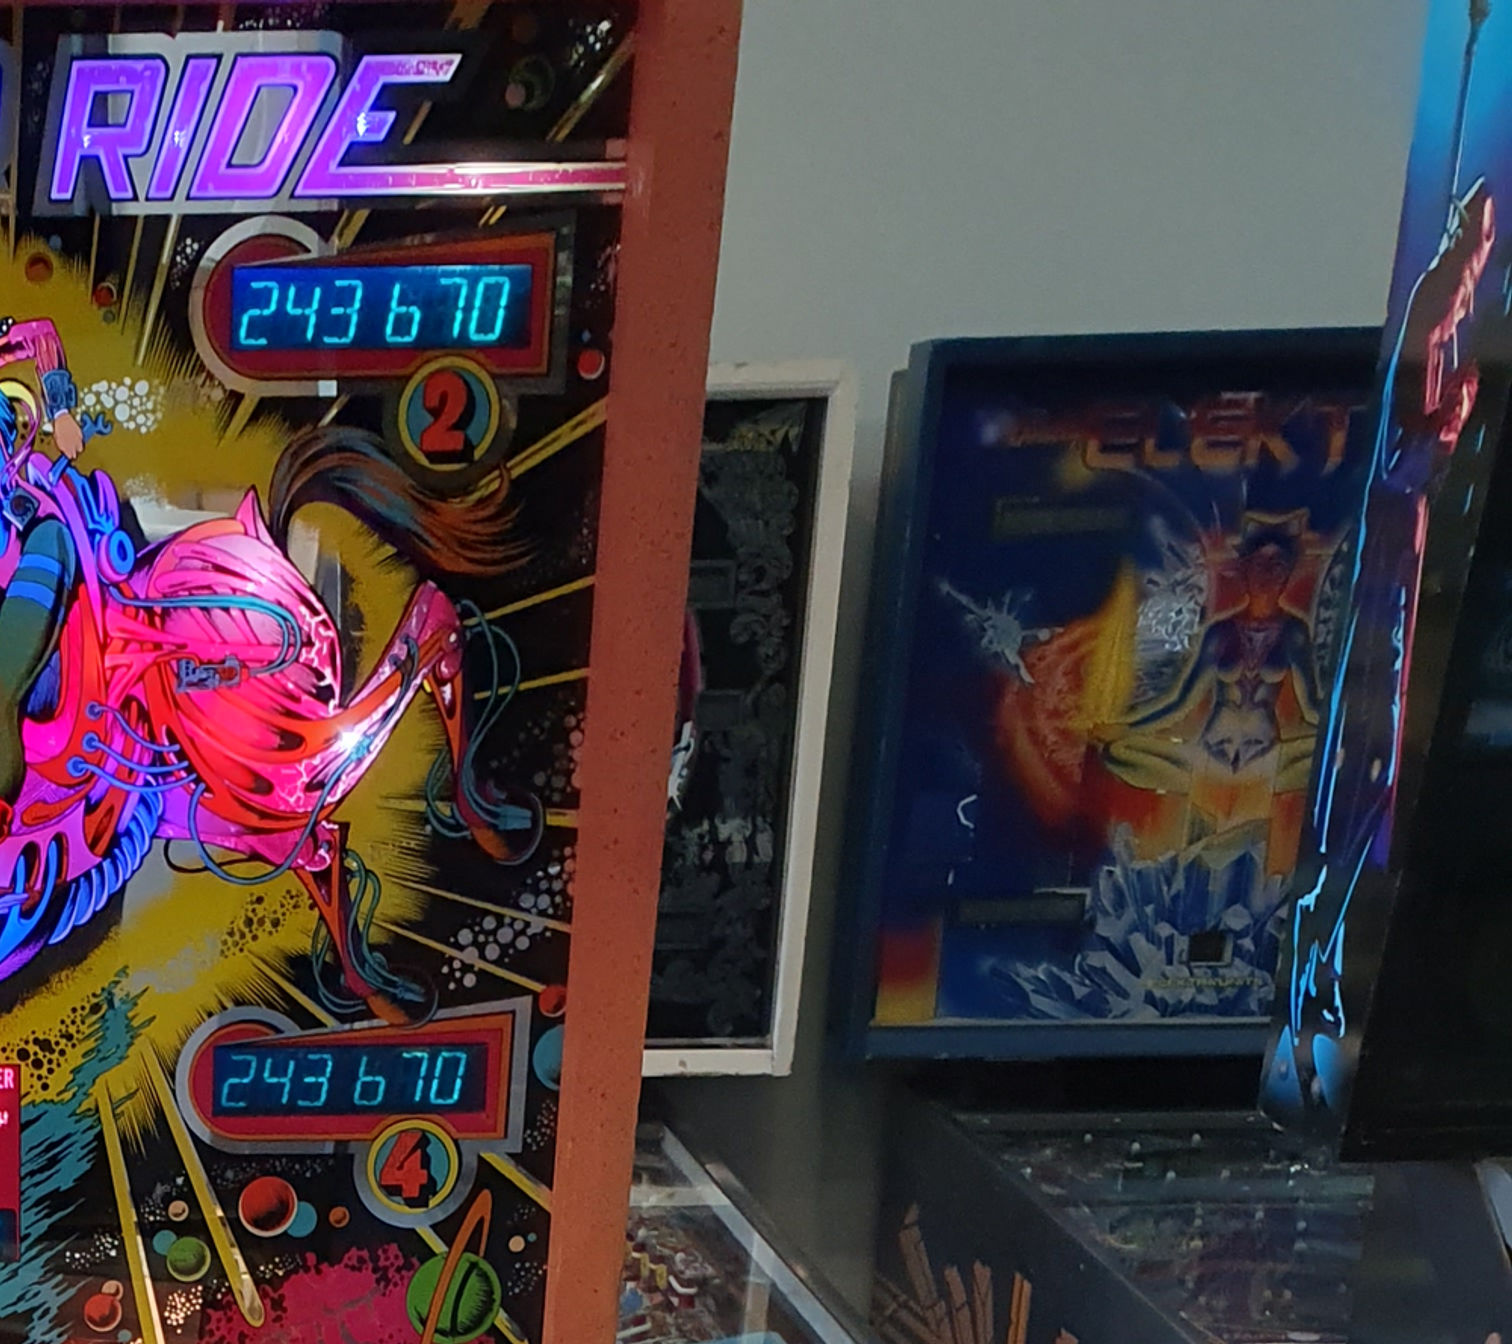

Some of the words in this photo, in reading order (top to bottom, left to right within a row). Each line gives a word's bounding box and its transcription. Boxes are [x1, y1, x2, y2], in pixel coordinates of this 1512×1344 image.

[48, 52, 464, 200] RIDE
[420, 371, 474, 463] 2
[379, 1131, 439, 1201] 4
